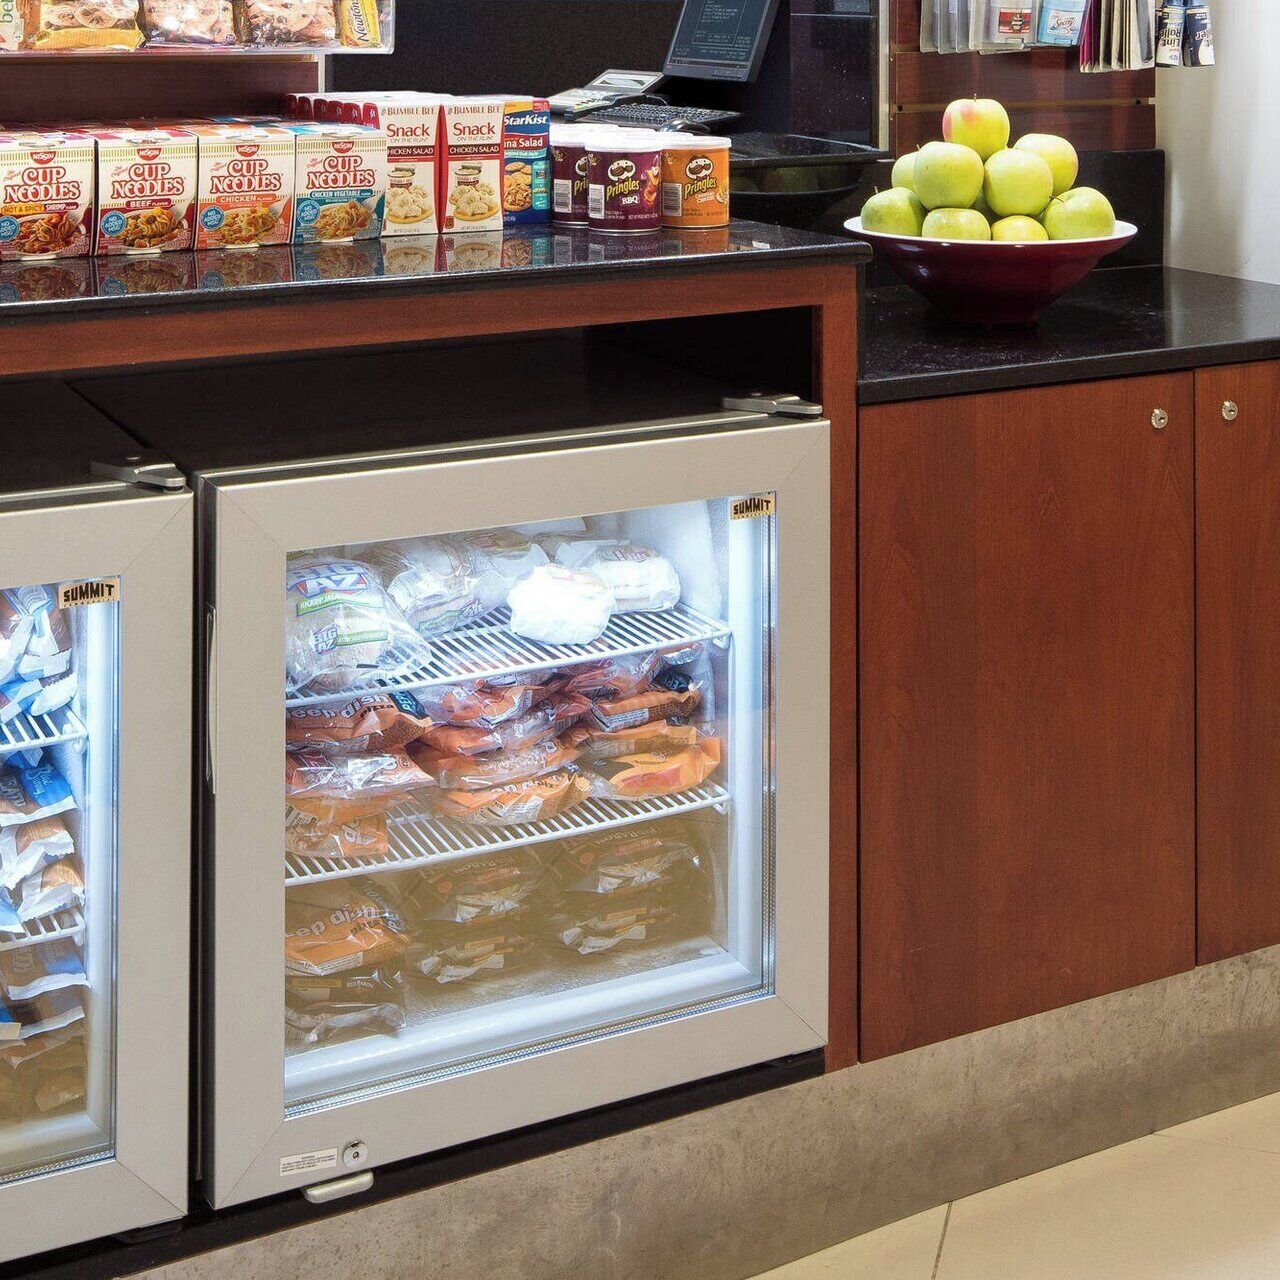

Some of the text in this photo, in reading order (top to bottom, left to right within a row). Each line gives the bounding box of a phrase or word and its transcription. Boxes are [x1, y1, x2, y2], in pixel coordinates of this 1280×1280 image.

[453, 122, 496, 136] Snack
[504, 115, 547, 126] StarKist
[387, 124, 431, 138] Snack
[449, 146, 478, 154] CHICKEN
[519, 138, 543, 148] Salad
[129, 163, 171, 181] CUP
[227, 159, 269, 178] CUP
[323, 155, 363, 173] CUP
[22, 167, 66, 185] CUP
[210, 174, 282, 194] NOODLES
[306, 170, 375, 190] NOODLES
[3, 181, 82, 204] NOODLES
[111, 177, 185, 200] NOODLES
[606, 176, 641, 202] Pringles
[684, 176, 717, 200] Pringles
[130, 200, 151, 208] BEEF
[220, 195, 256, 203] CHICKEN
[622, 195, 639, 205] BBQ
[24, 205, 43, 213] SPICY
[732, 498, 772, 517] SUMMIT
[63, 583, 115, 603] SUMMIT
